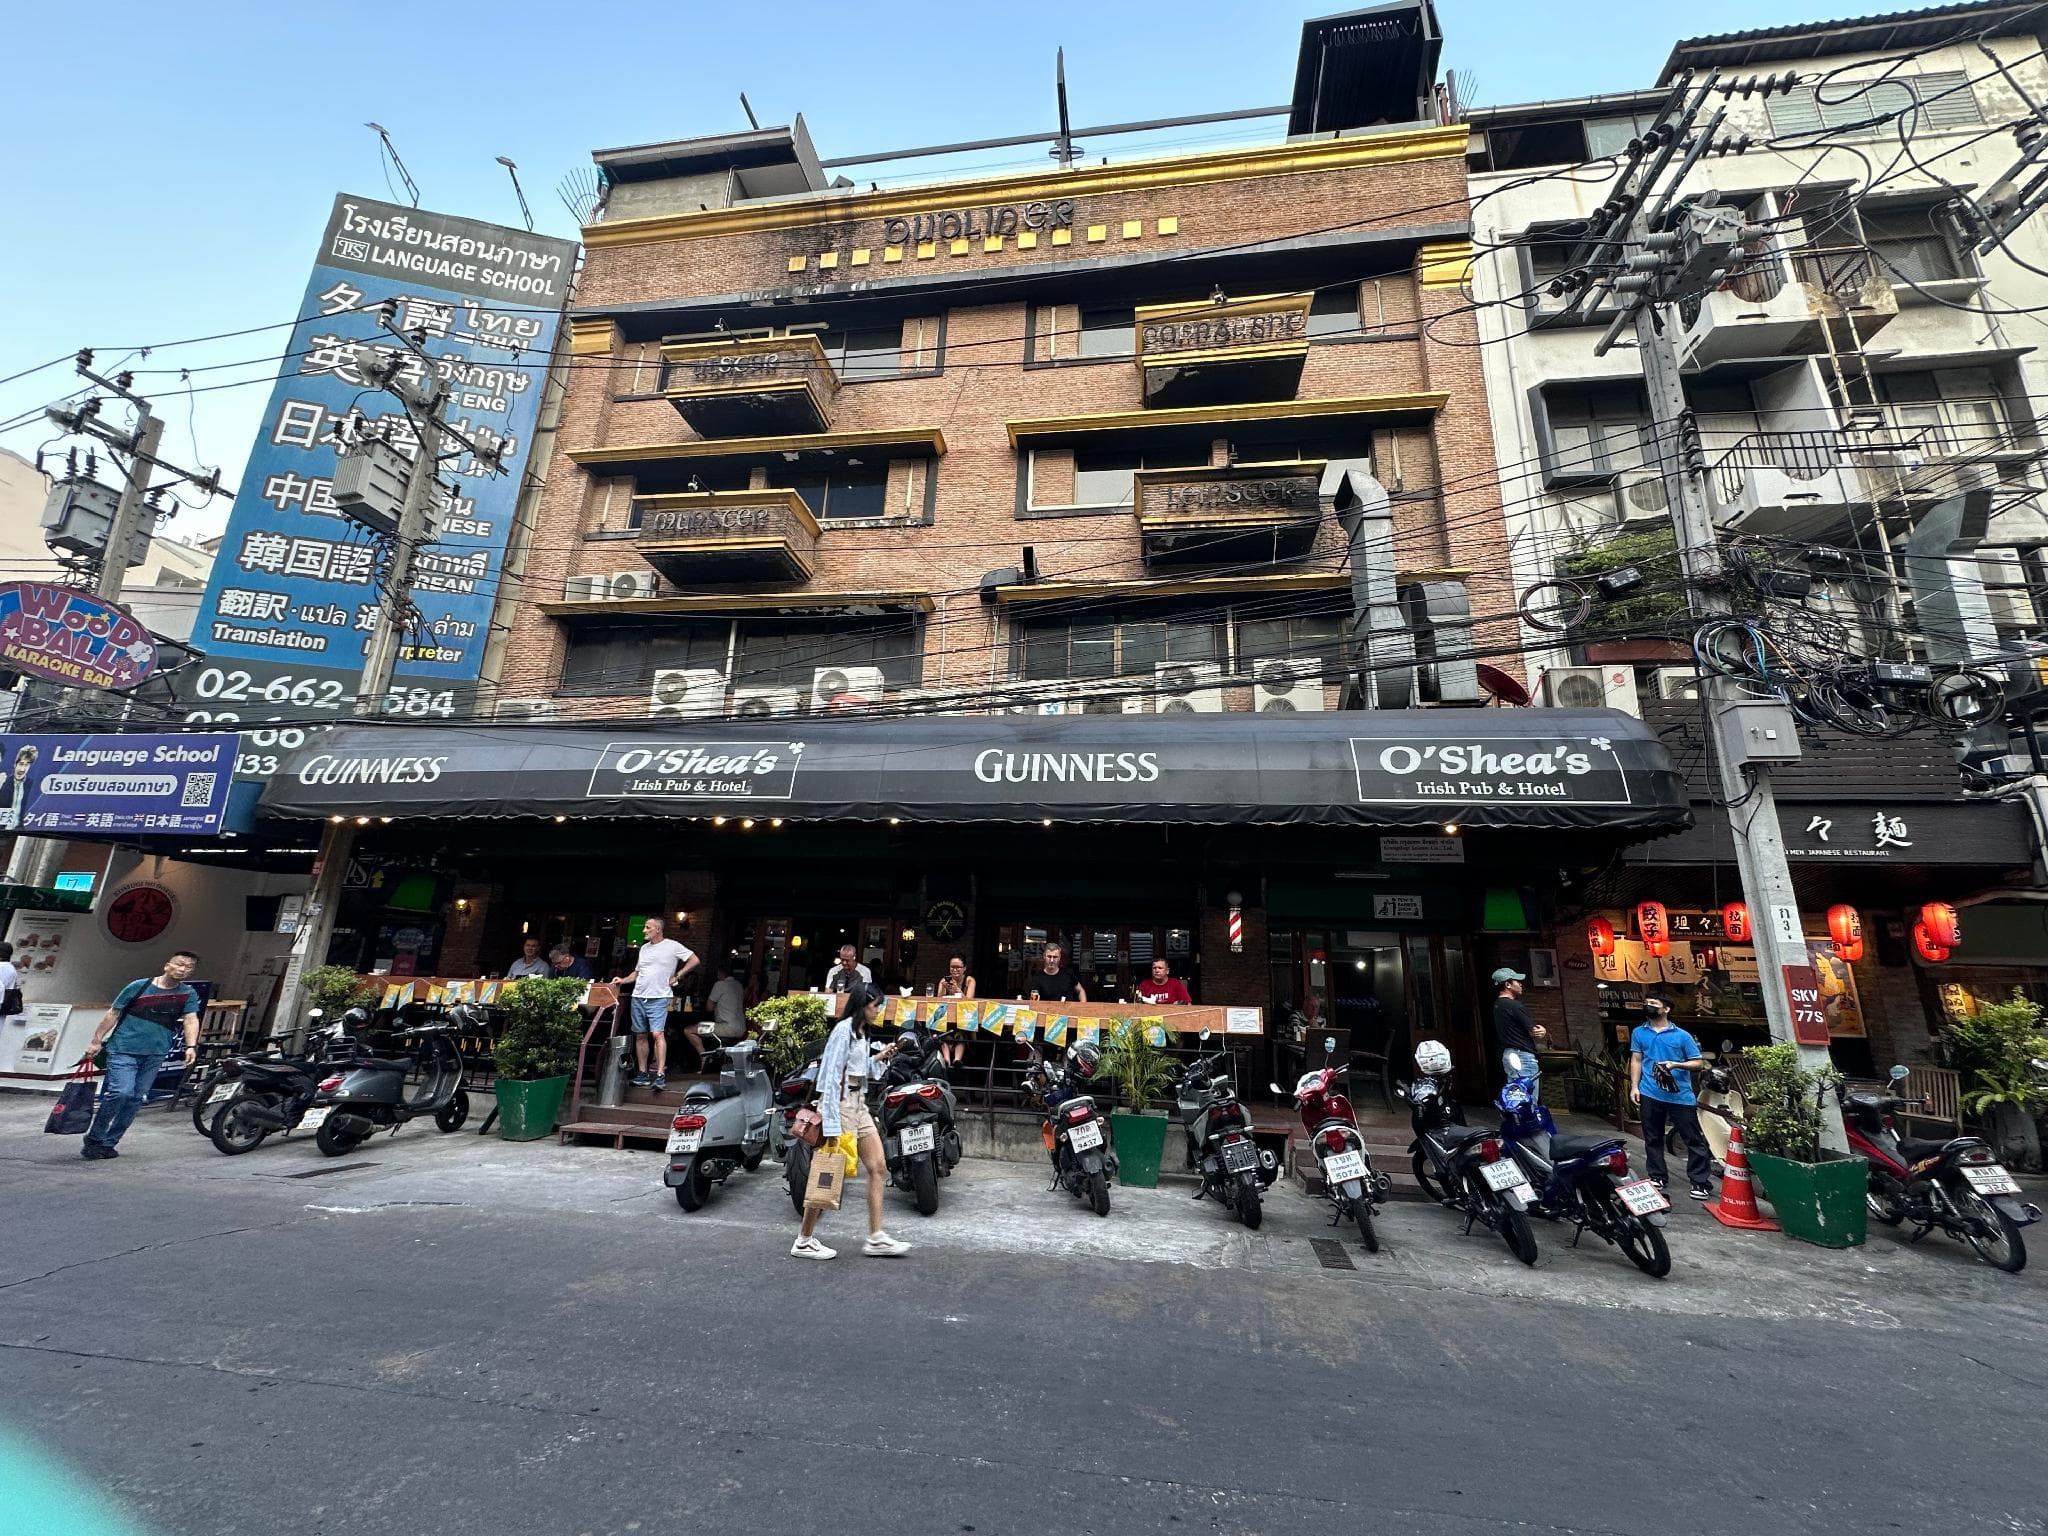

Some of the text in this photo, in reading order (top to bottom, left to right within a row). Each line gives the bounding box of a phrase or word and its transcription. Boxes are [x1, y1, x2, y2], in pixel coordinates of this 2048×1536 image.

[343, 203, 561, 273] โรงเรียนสอนภาษา
[371, 246, 478, 282] LANGUAGE
[480, 268, 555, 296] SCHOOL
[461, 394, 506, 412] ENG
[240, 531, 374, 584] 韓国語
[300, 603, 347, 626] แปล
[434, 614, 476, 637] ล่าม
[21, 616, 121, 675] BALL
[213, 623, 326, 650] Translation
[4, 644, 113, 688] KARAOKE BAR
[53, 744, 220, 767] Language School
[615, 748, 780, 775] O'Shea's
[974, 748, 1159, 783] GUINNESS
[1379, 745, 1592, 775] O'Shea's
[299, 754, 448, 785] GUINNESS
[49, 776, 171, 794] โรงเรียนสอนภาษา
[631, 779, 747, 794] Irish Pub & Hotel
[1416, 781, 1566, 796] Irish Pub & Hotel
[24, 812, 60, 827] タイ語
[85, 813, 114, 828] 英語
[144, 814, 182, 828] 日本語
[1599, 990, 1620, 1000] OPEN
[1792, 988, 1818, 1002] SKV
[1796, 1010, 1824, 1023] 77S
[1730, 1168, 1750, 1178] ISUZ
